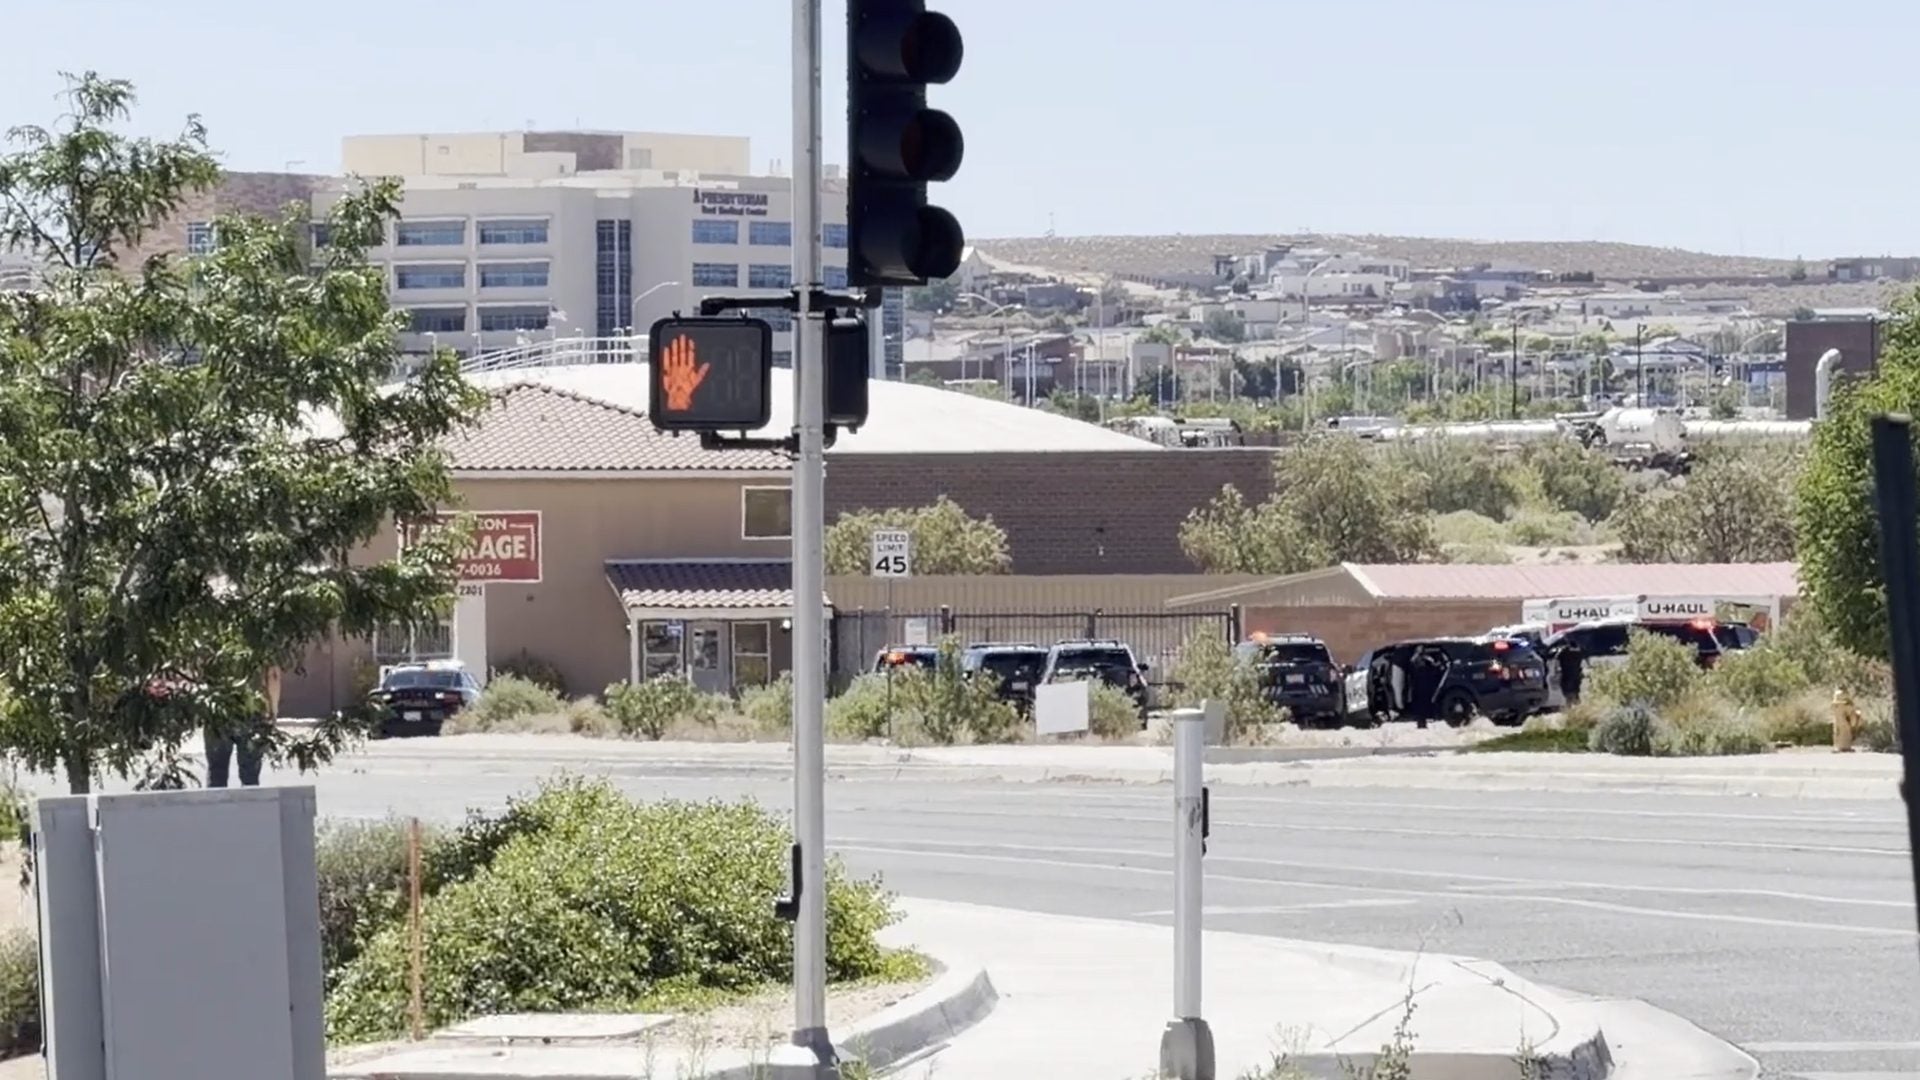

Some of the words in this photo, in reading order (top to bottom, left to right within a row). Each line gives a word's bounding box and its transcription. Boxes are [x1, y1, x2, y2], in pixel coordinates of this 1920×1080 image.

[876, 533, 907, 543] SPEED
[877, 544, 904, 552] LIMIT
[875, 555, 907, 574] 45
[1559, 607, 1610, 619] U-HAU
[1648, 603, 1708, 614] U-HAUL
